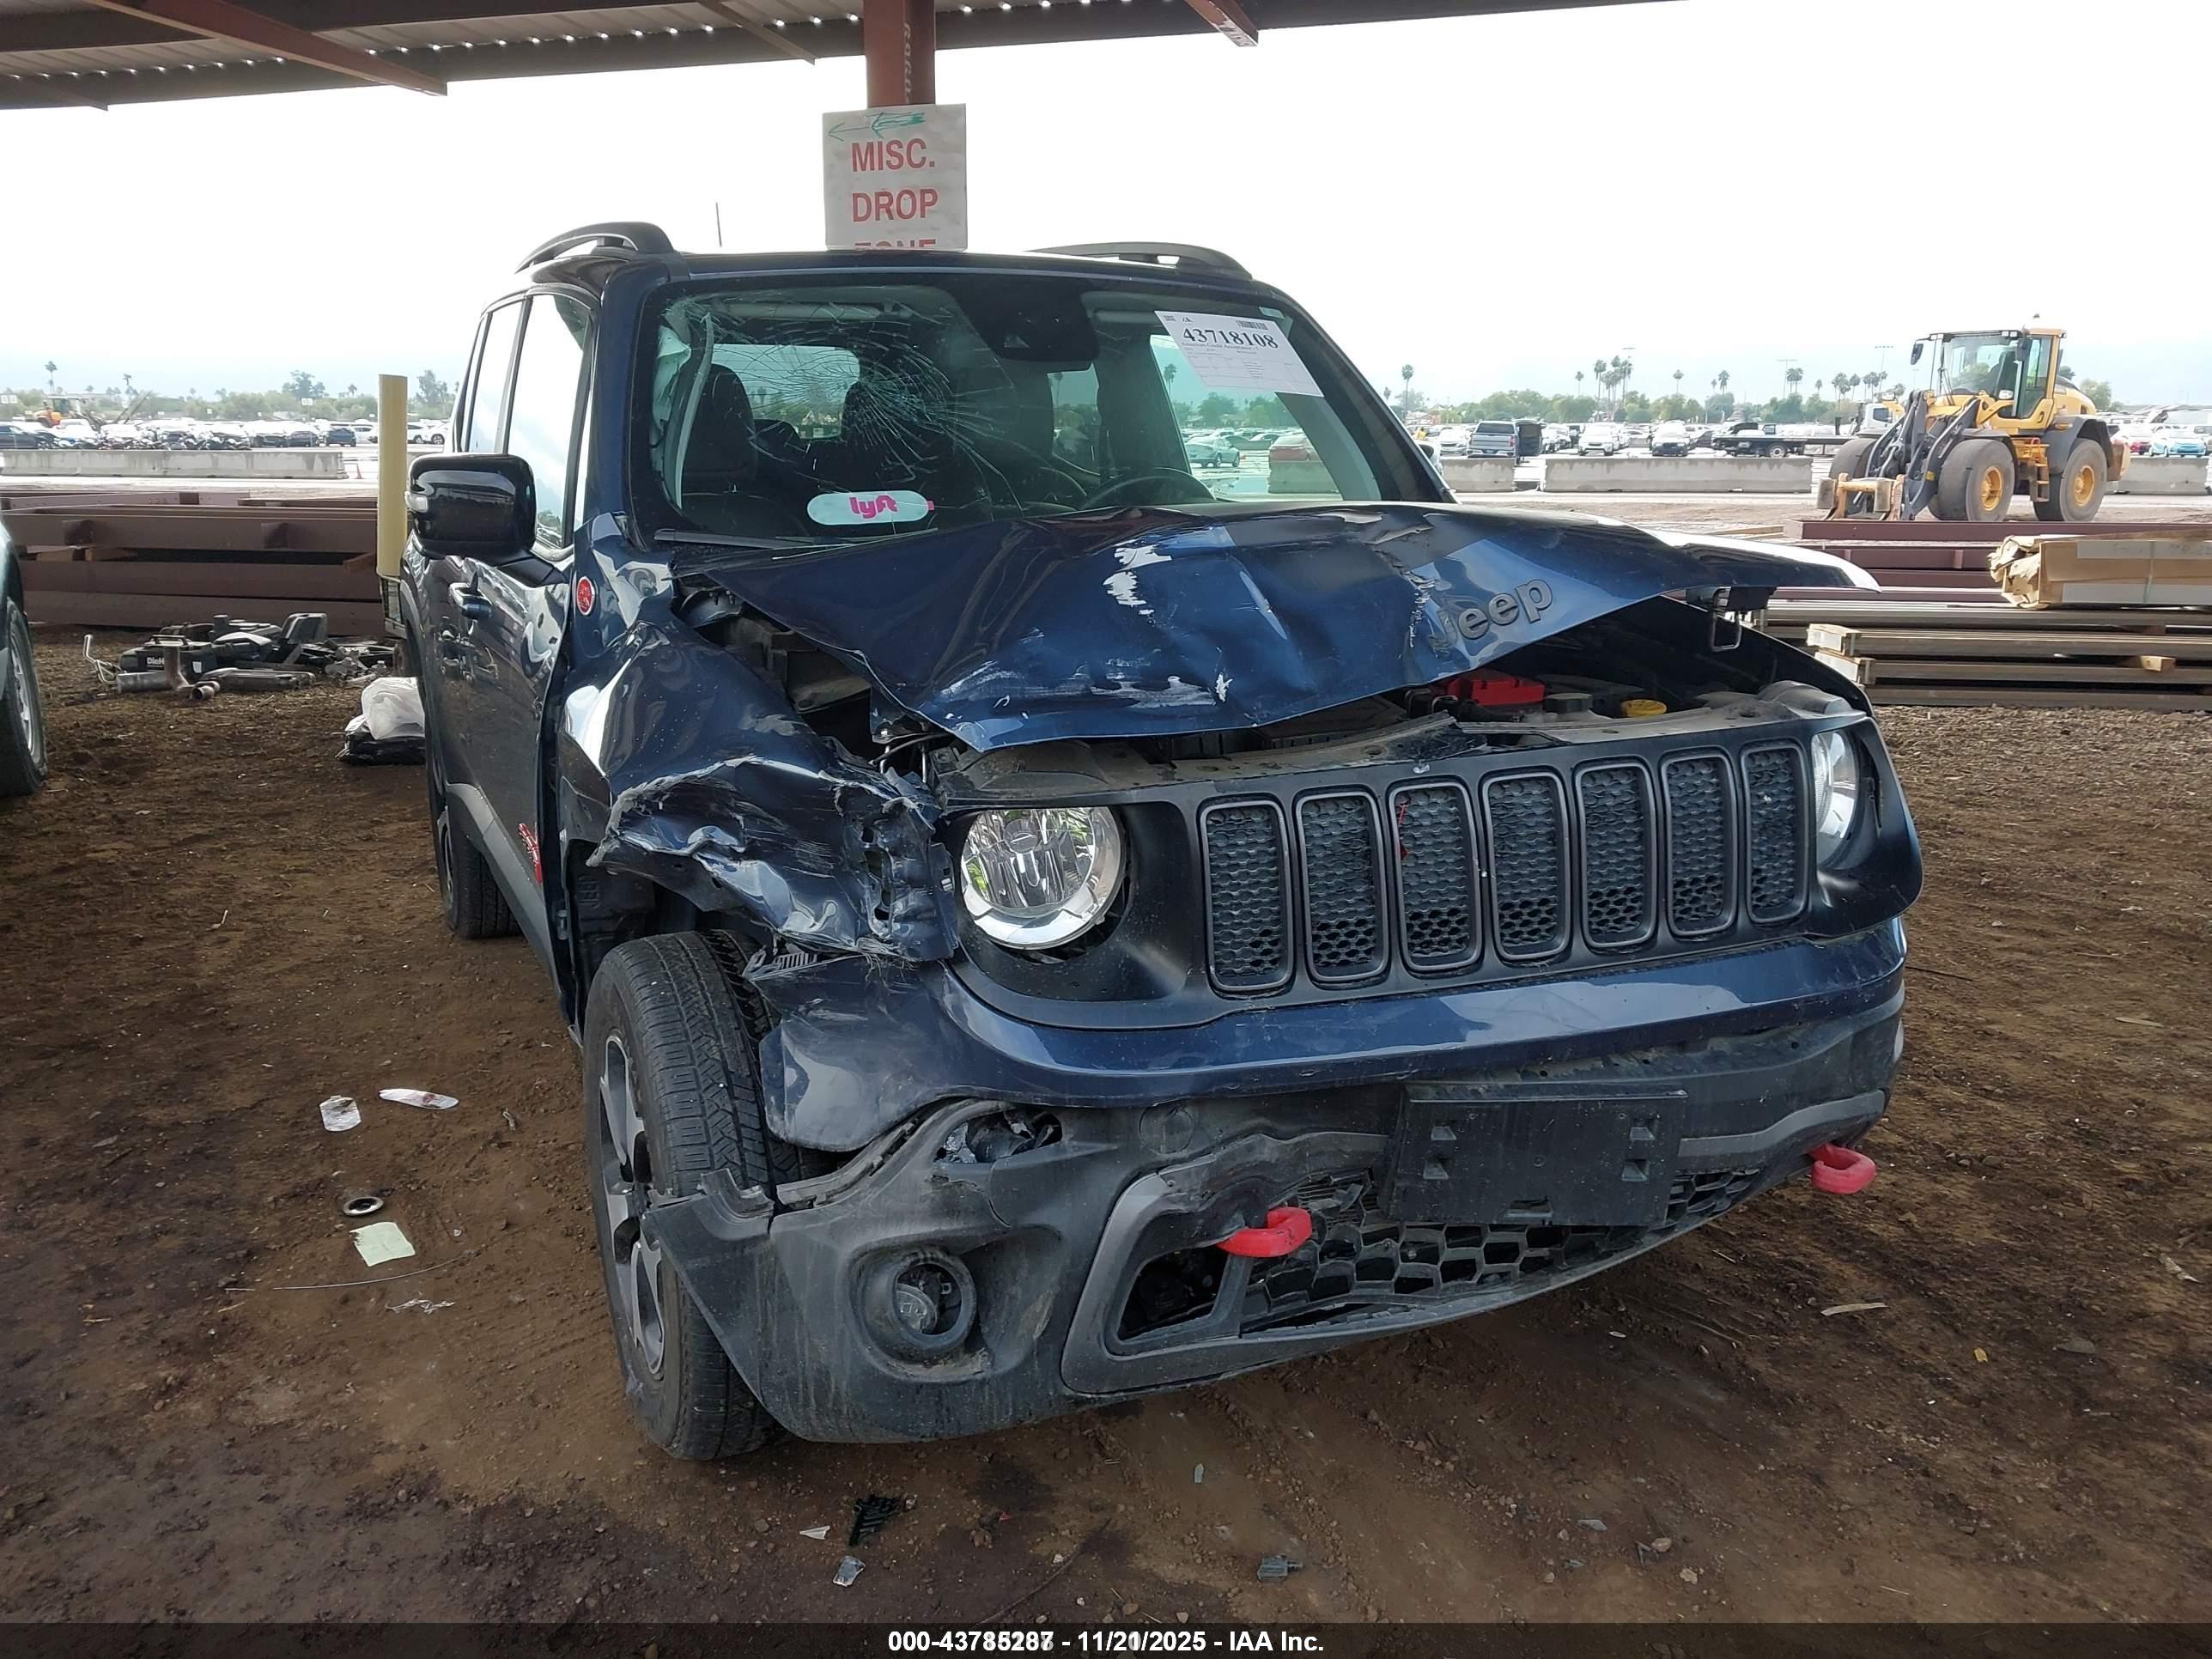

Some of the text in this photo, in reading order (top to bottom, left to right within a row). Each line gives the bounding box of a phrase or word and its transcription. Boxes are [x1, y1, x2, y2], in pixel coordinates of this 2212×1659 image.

[851, 137, 935, 172] MISC.
[851, 188, 939, 222] DROP
[1183, 328, 1279, 349] 43718108
[849, 495, 898, 520] lyft
[1429, 579, 1553, 657] Jeep
